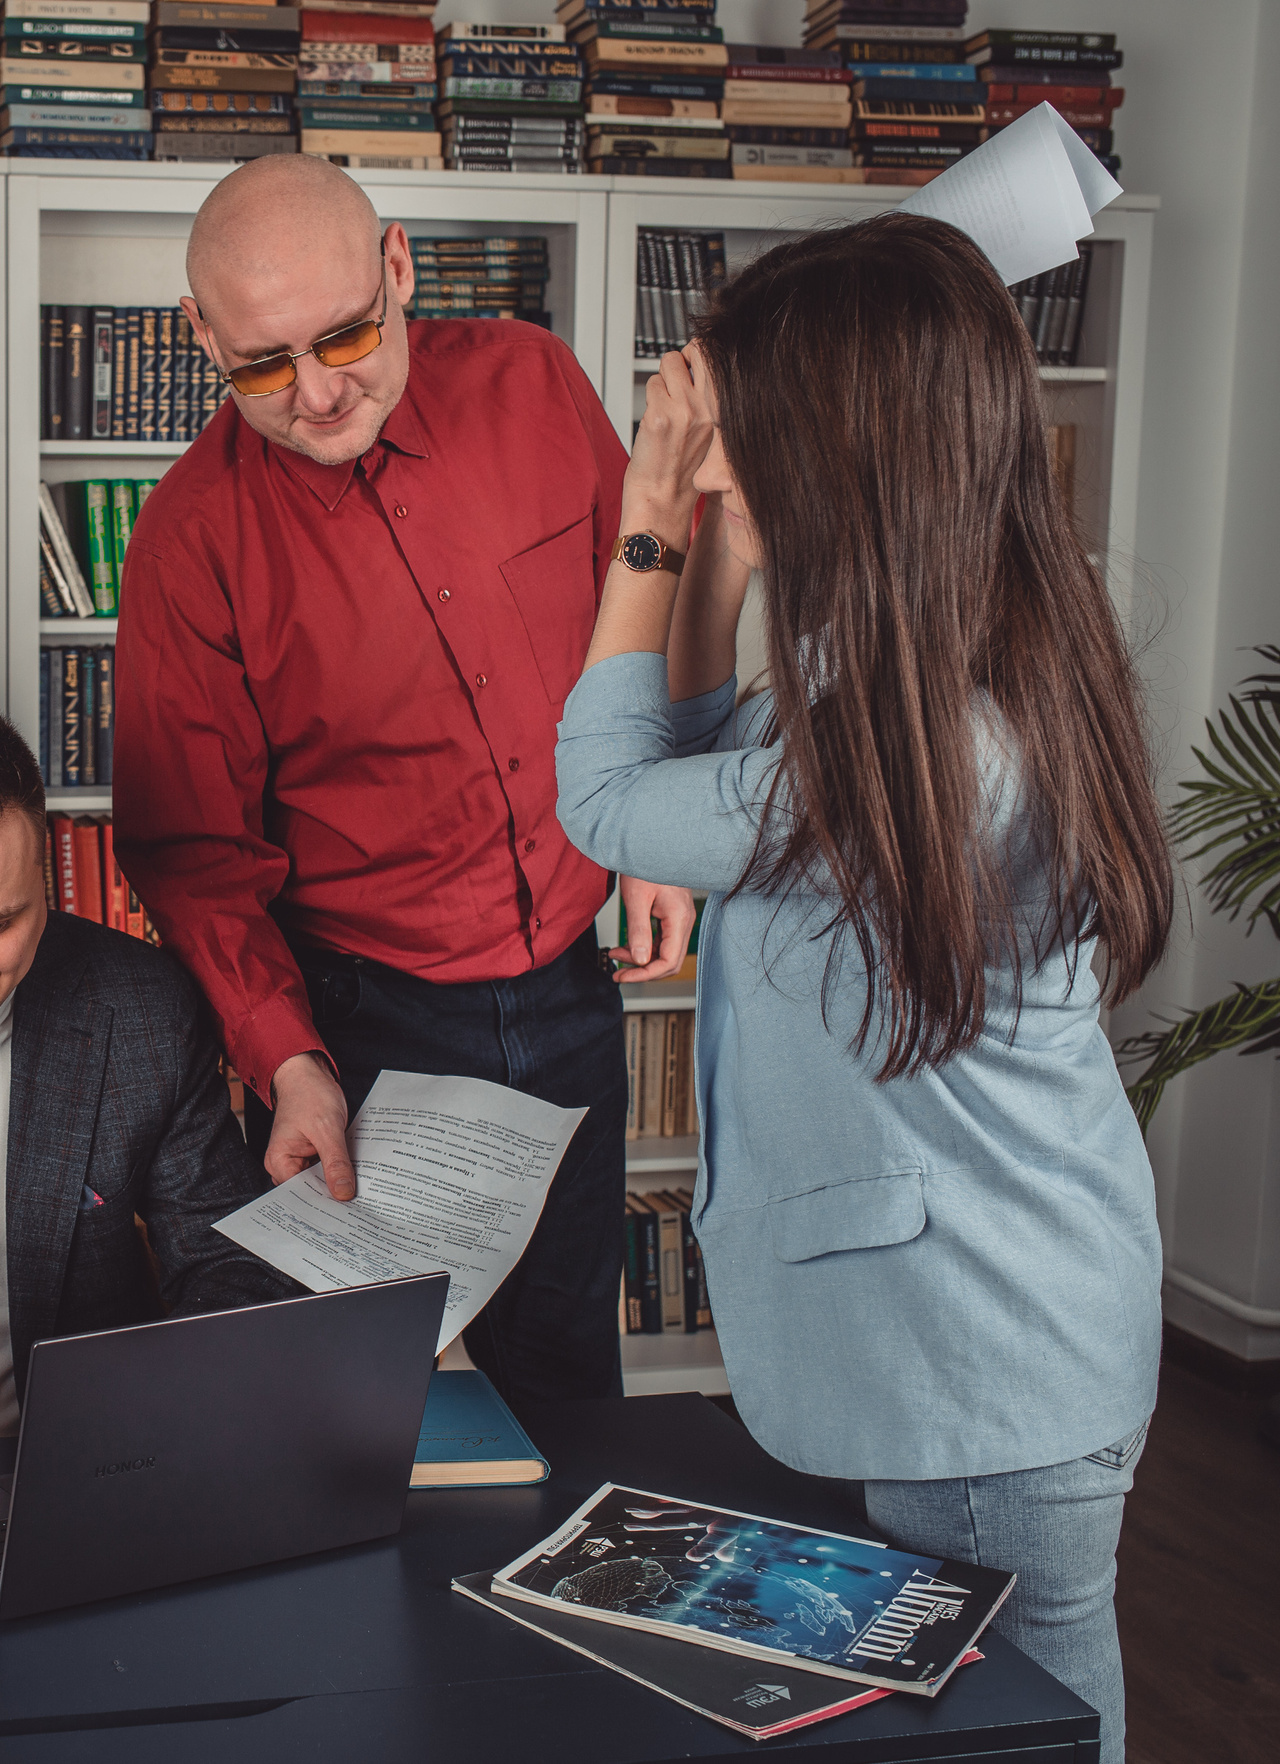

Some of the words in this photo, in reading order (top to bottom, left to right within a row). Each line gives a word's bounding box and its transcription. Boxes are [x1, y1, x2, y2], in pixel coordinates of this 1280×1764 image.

[62, 834, 74, 899] КУРСКАЯ
[452, 1166, 470, 1176] Права
[95, 1457, 155, 1478] HONOR
[590, 1545, 608, 1558] РЭШ
[849, 1569, 972, 1665] Alumni
[924, 1602, 947, 1626] MAGAZINE
[940, 1604, 963, 1620] NES
[746, 1694, 780, 1708] РЭШ
